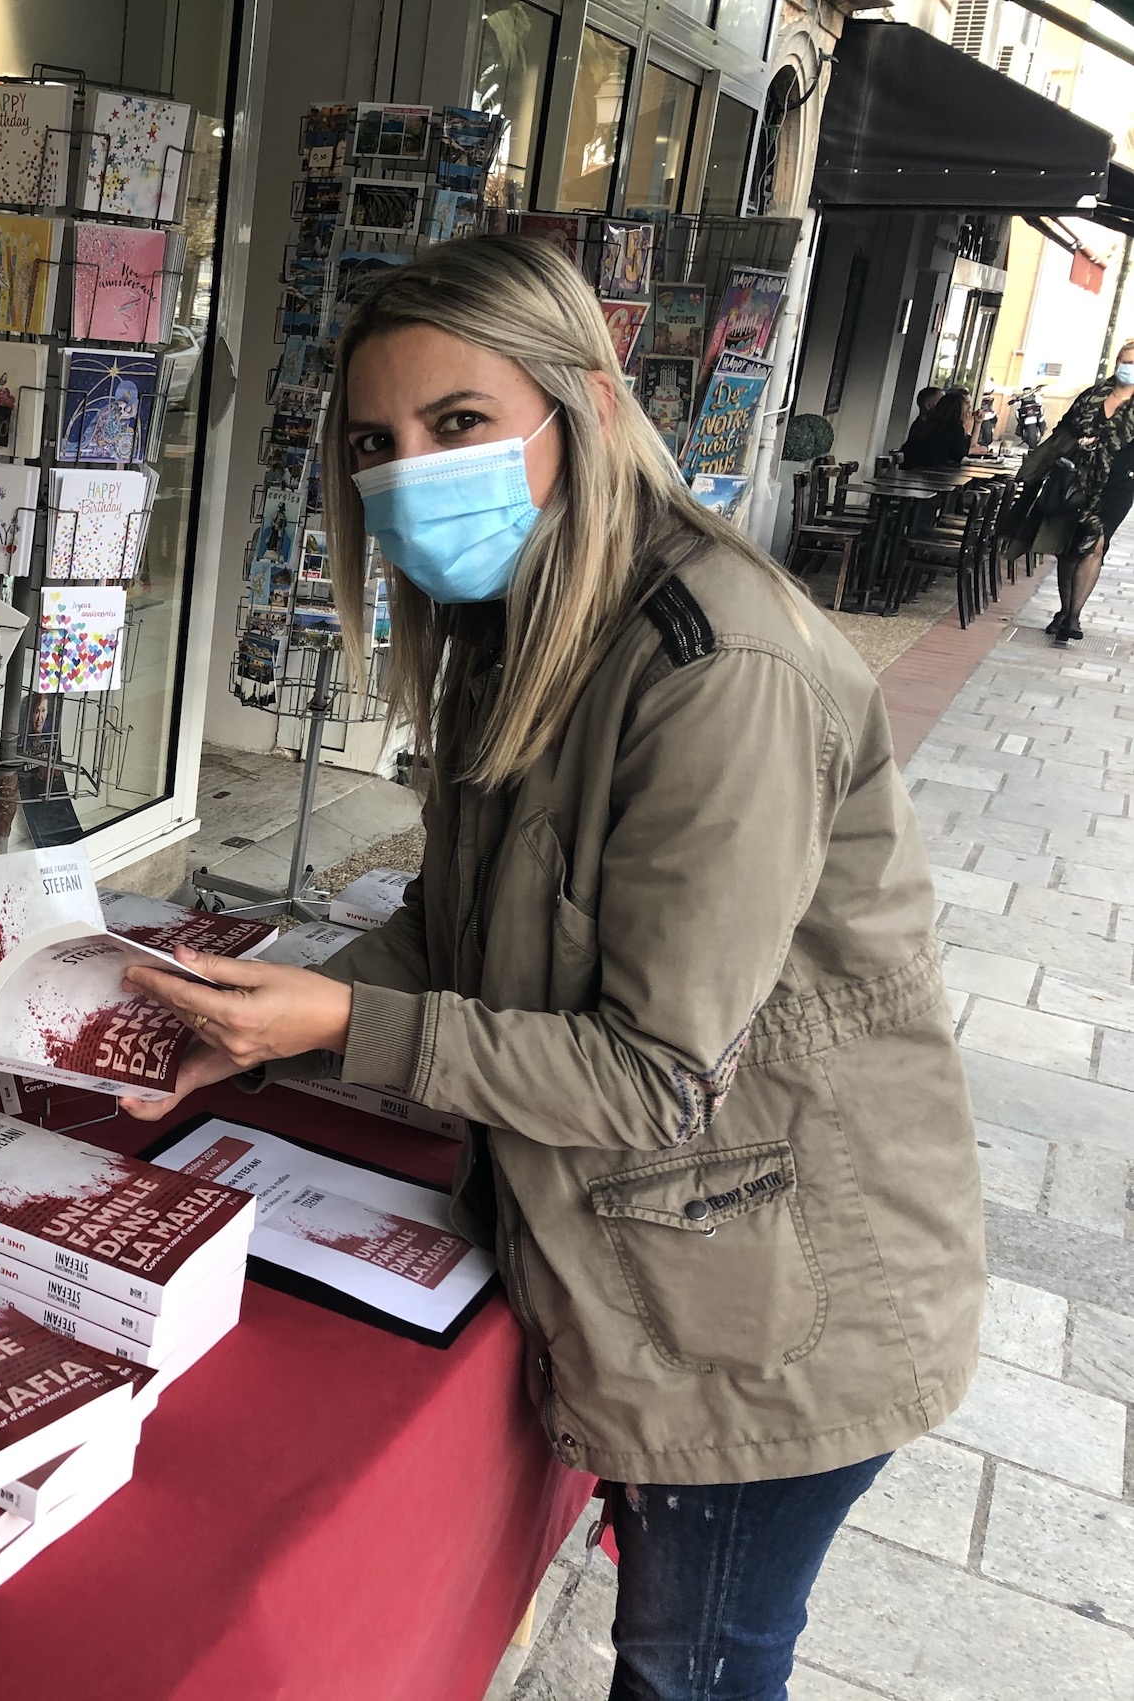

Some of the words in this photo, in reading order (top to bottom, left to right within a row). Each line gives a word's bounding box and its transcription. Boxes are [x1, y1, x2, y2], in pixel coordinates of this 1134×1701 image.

[733, 273, 757, 289] HAPPY
[722, 357, 747, 372] HAPPY
[711, 381, 740, 410] De
[699, 407, 750, 436] NOTRE
[88, 482, 122, 499] HAPPY
[81, 498, 122, 519] Birthday
[39, 863, 79, 876] MARIE-FRANÇOISE
[42, 874, 83, 895] STEFANI
[346, 912, 368, 922] MAFIA
[144, 927, 179, 945] UNE
[161, 918, 216, 950] FAMILLE
[187, 932, 218, 950] ANS
[211, 923, 255, 948] MAFIA
[62, 947, 125, 966] STEFANI
[95, 1002, 140, 1068] UNE
[129, 1007, 173, 1076] DAN
[145, 1039, 171, 1079] LA
[160, 1052, 172, 1080] Corse,
[24, 1082, 46, 1093] Corse,
[380, 1099, 409, 1114] STEFANI
[234, 1158, 263, 1179] STEFANI
[706, 1187, 743, 1211] TEDDY
[743, 1170, 783, 1198] SMITH
[41, 1198, 100, 1238] UNE
[66, 1177, 160, 1249] FAMILLE
[92, 1206, 160, 1259] DANS
[118, 1240, 162, 1269] LA
[148, 1186, 221, 1240] MAFIA
[7, 1239, 26, 1252] UNE
[354, 1238, 385, 1258] UNE
[370, 1229, 418, 1267] FAMILLE
[55, 1251, 88, 1275] STEFANI
[143, 1253, 164, 1272] Corse,
[388, 1247, 423, 1274] DANS
[405, 1267, 428, 1281] LA
[423, 1236, 457, 1267] MAFIA
[0, 1266, 19, 1280] UNE
[48, 1280, 81, 1303] STEFANI
[44, 1310, 76, 1333] STEFANI
[10, 1404, 36, 1421] d'une
[34, 1385, 72, 1408] violence
[70, 1374, 92, 1391] sans
[89, 1371, 104, 1382] fin
